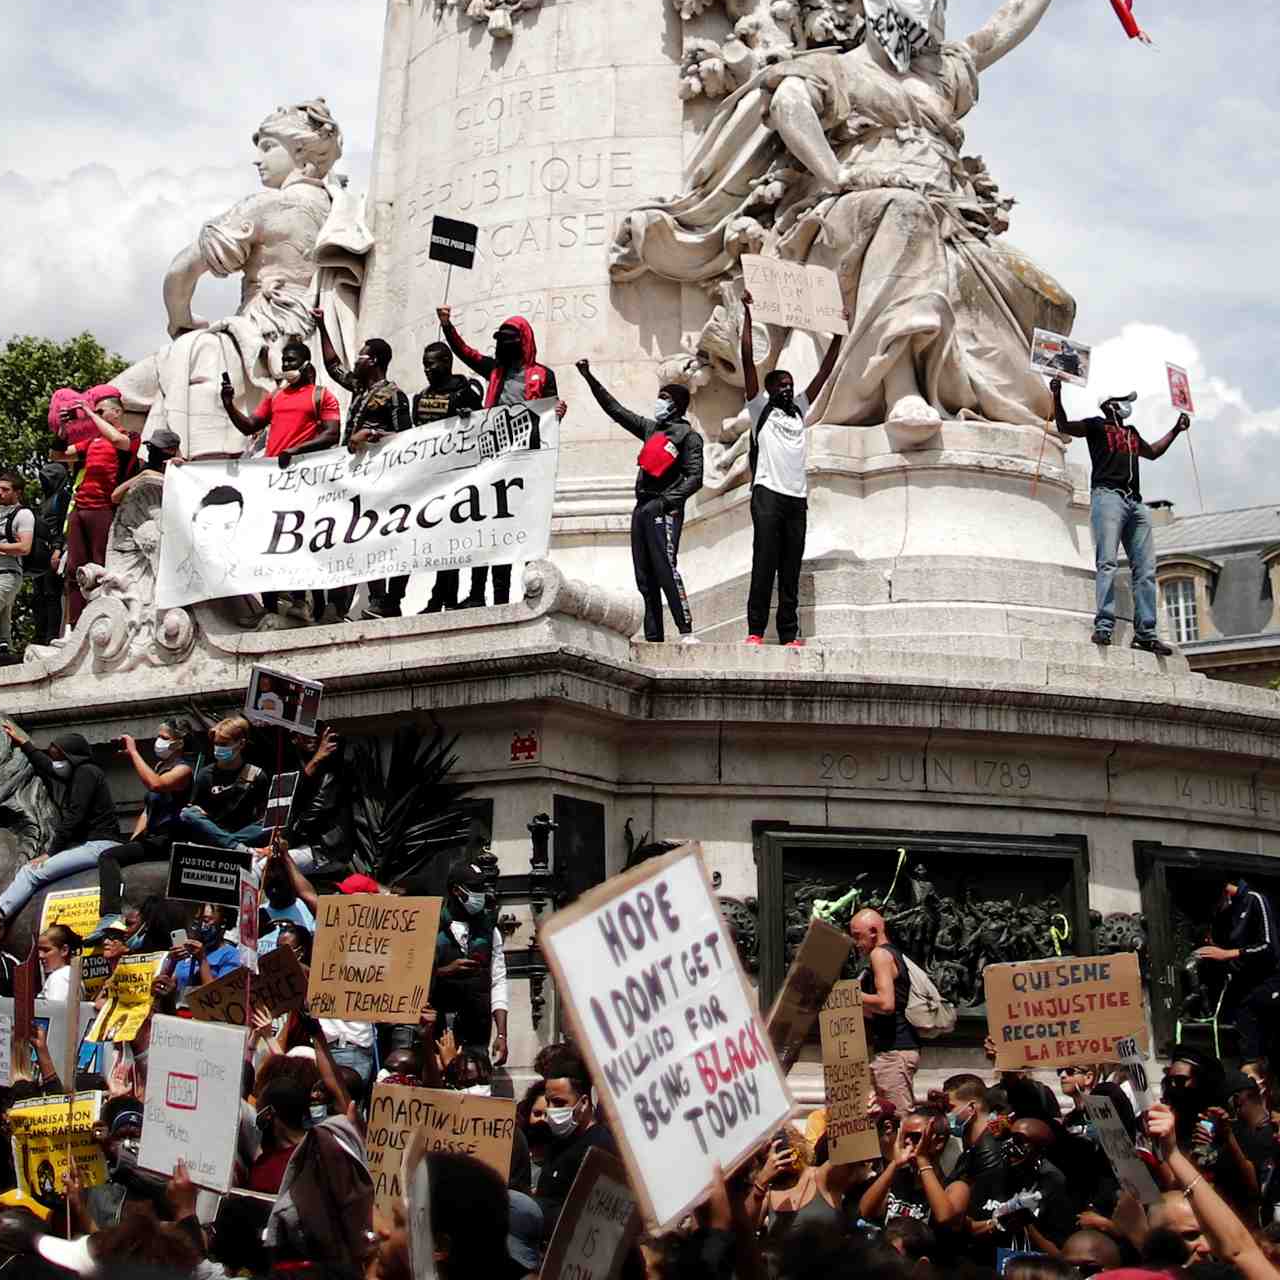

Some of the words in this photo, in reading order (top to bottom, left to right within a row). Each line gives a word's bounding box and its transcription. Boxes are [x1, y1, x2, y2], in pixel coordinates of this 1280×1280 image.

[455, 86, 555, 131] GLOIRE
[515, 292, 600, 328] PARIS
[373, 426, 477, 472] JUSTICE
[260, 476, 524, 556] Babacar
[365, 543, 401, 568] par
[412, 533, 434, 558] la
[447, 527, 529, 559] police
[423, 553, 474, 569] Rennes
[820, 752, 858, 781] 20
[877, 756, 957, 786] JUIN
[975, 760, 1032, 791] 1789
[1174, 775, 1193, 801] 14
[180, 857, 217, 868] JUSTICE
[325, 905, 341, 928] LA
[348, 903, 421, 933] JEUNESSE
[597, 881, 682, 969] HOPE
[338, 930, 391, 955] S'ÉLÈVE
[681, 931, 723, 987] GET
[320, 961, 337, 982] LE
[339, 965, 386, 984] MONDE
[1012, 971, 1053, 993] QUI
[1056, 963, 1111, 987] SEME
[683, 993, 729, 1041] FOR
[1007, 991, 1131, 1019] L'INJUSTICE
[1002, 1019, 1082, 1043] RECOLTE
[838, 1041, 849, 1060] LE
[1023, 1043, 1051, 1062] LA
[634, 1061, 691, 1141] BEING
[691, 1019, 769, 1095] BLACK
[372, 1096, 450, 1130] MARTIN
[451, 1113, 515, 1139] LUTHER
[683, 1071, 762, 1156] TODAY
[367, 1127, 412, 1151] NOUS
